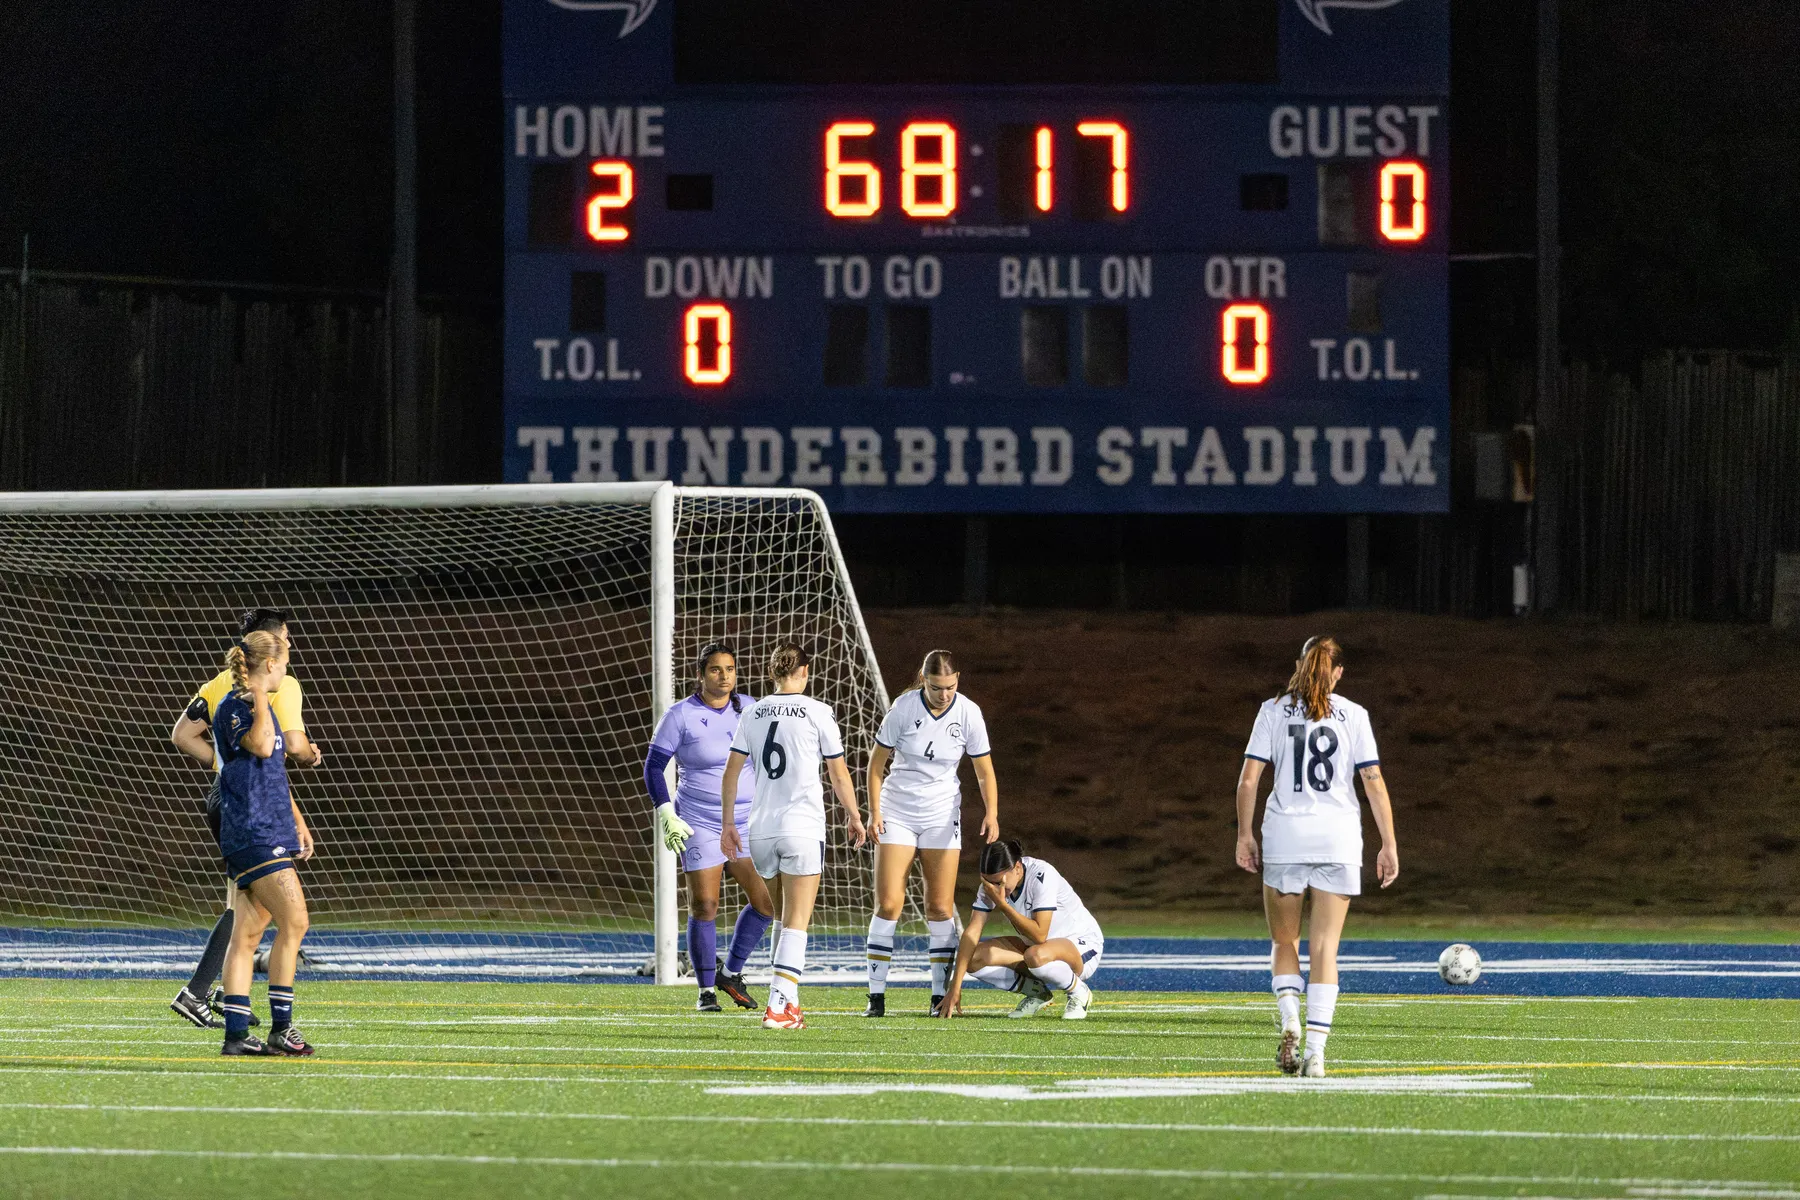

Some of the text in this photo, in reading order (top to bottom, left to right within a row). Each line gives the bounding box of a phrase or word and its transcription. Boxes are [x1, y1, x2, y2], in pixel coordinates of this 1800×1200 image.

[515, 106, 665, 157] HOME
[1270, 106, 1439, 157] GUEST
[587, 161, 633, 240] 2
[1380, 161, 1426, 241] 0
[645, 257, 773, 299] DOWN
[817, 257, 942, 299] TO GO
[1000, 257, 1152, 299] BALL ON
[1205, 257, 1286, 301] QTR
[534, 339, 642, 381] T.O.L.
[684, 304, 731, 384] 0
[1222, 304, 1269, 384] 0
[1310, 339, 1419, 381] T.O.L.
[517, 426, 1437, 486] THUNDERBIRD STADIUM
[755, 705, 807, 720] SPARTANS
[762, 720, 787, 780] 6
[923, 740, 935, 761] 4
[1288, 724, 1339, 793] 18
